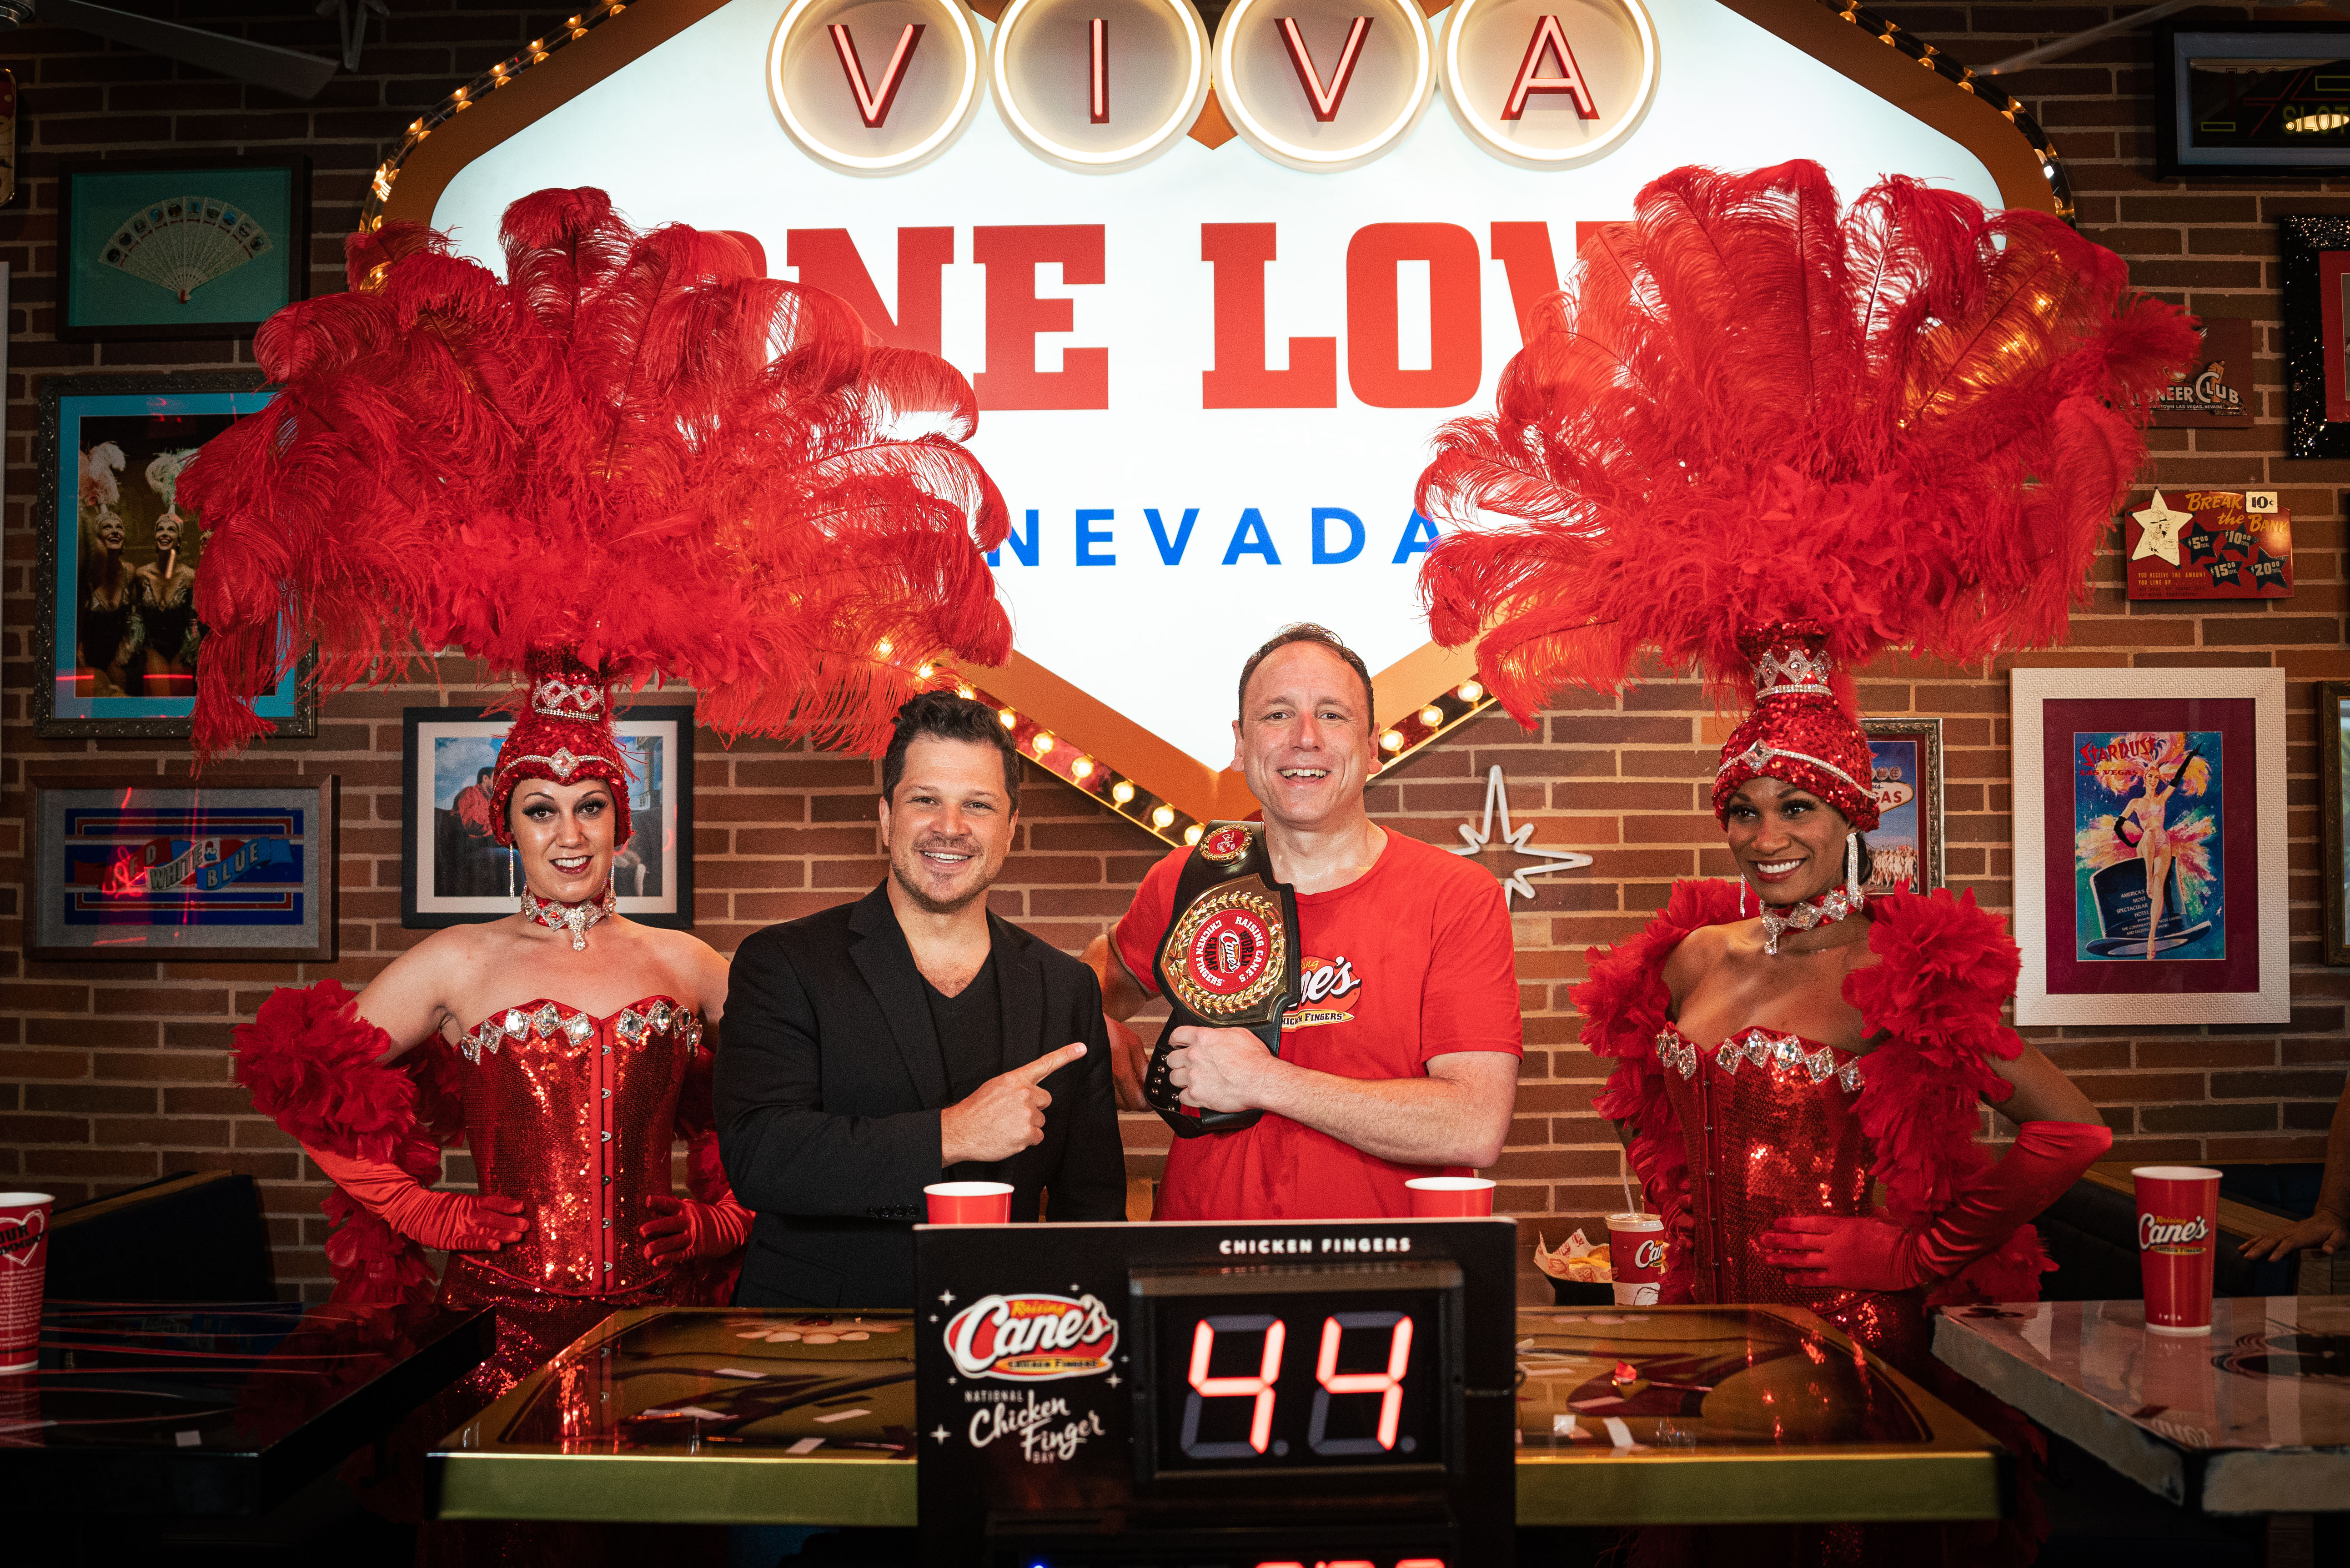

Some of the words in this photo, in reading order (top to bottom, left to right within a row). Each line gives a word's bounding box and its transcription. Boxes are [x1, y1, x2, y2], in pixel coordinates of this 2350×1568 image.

[827, 15, 1600, 127] VIVA
[732, 224, 1110, 410] NE
[1201, 221, 1635, 408] LOV
[2156, 387, 2194, 402] NEER
[2196, 372, 2239, 404] CLUB
[2185, 493, 2243, 511] BREAK
[987, 506, 1441, 566] NEVADA
[2218, 509, 2244, 525] the
[2248, 514, 2290, 534] BANK
[2079, 735, 2157, 767] STARDUST
[150, 844, 203, 890] WHITE
[207, 843, 259, 888] BLUE
[2116, 903, 2148, 914] SPECTACULAR
[2121, 889, 2145, 898] AMERICA'S
[1195, 920, 1222, 955] CHICKEN
[1235, 916, 1264, 950] RAISING
[1240, 930, 1254, 966] WORLD
[1205, 937, 1219, 970] CHAMP
[1220, 932, 1240, 972] Cane's
[1239, 950, 1264, 983] CANE'S
[1301, 959, 1319, 971] ising
[1195, 957, 1223, 986] FINGERS
[1301, 956, 1361, 1003] ne's
[1305, 1013, 1343, 1021] FINGERS
[1219, 1238, 1312, 1254] CHICKEN
[1321, 1237, 1410, 1253] FINGERS
[2139, 1213, 2209, 1250] Cane's
[955, 1296, 1112, 1372] Cane's
[964, 1390, 1024, 1403] NATIONAL
[1188, 1316, 1413, 1454] 44
[969, 1389, 1071, 1448] Chicken
[1019, 1410, 1106, 1462] Finger
[1032, 1452, 1055, 1464] DAY
